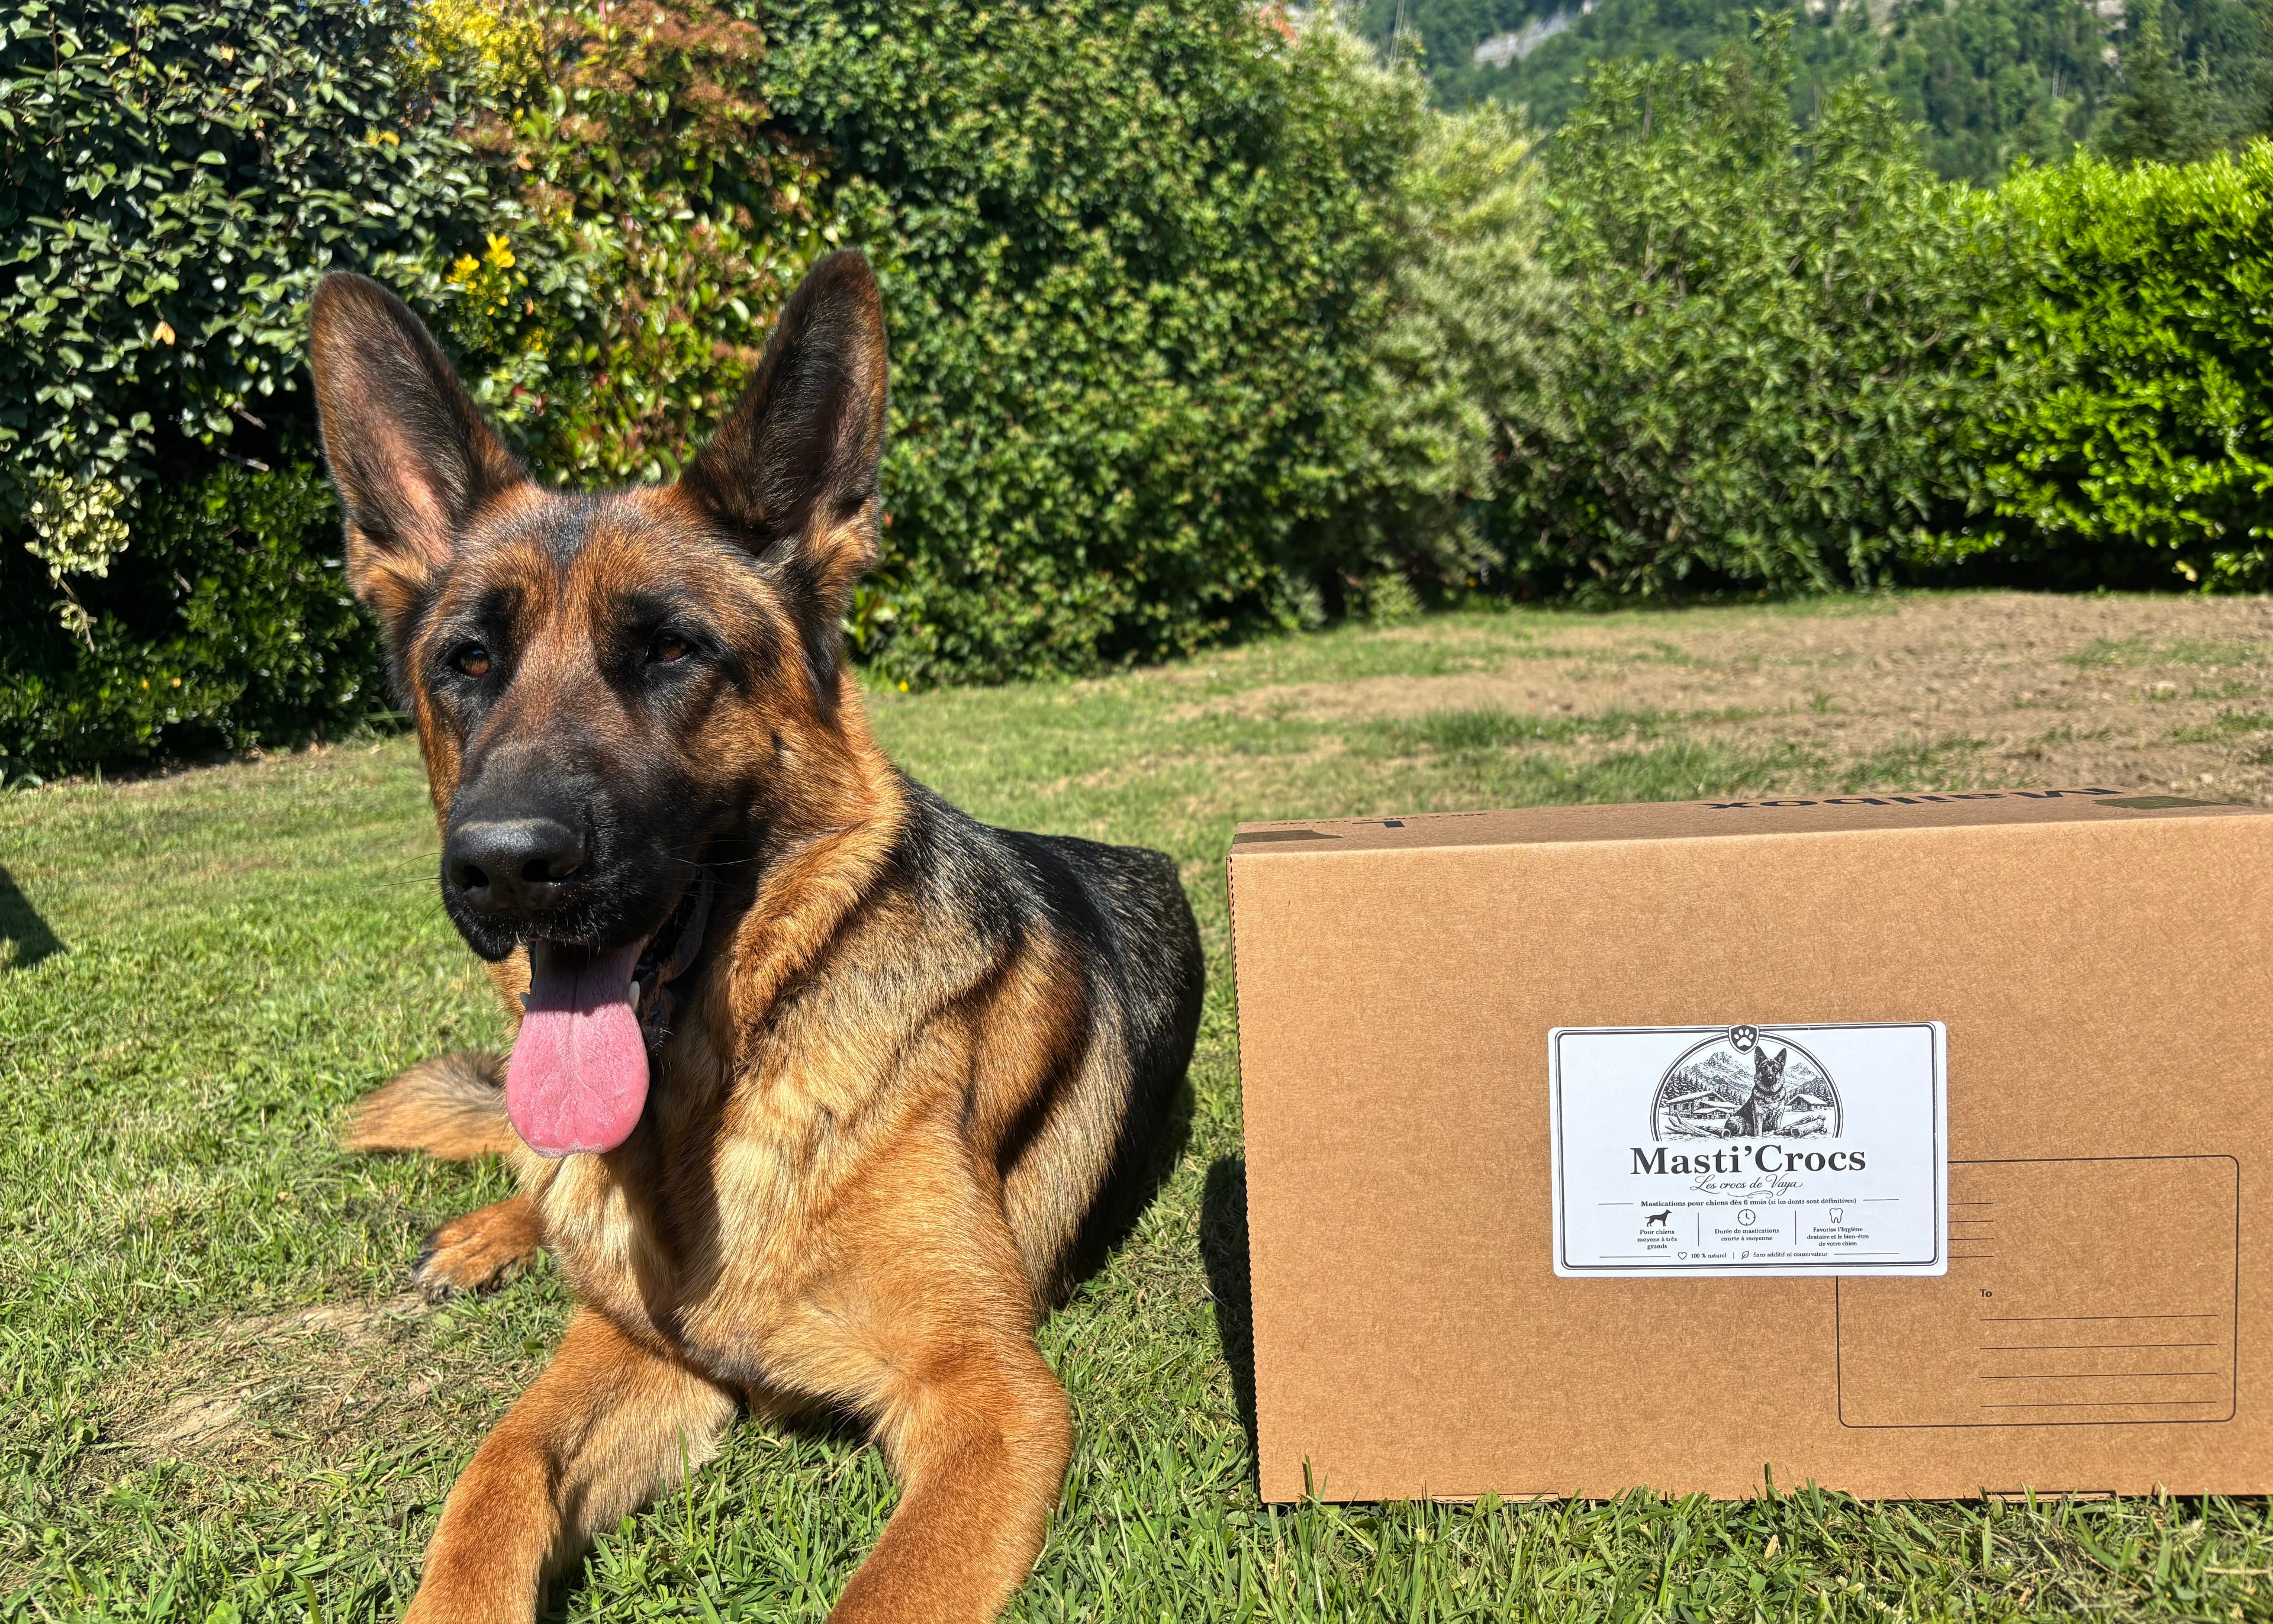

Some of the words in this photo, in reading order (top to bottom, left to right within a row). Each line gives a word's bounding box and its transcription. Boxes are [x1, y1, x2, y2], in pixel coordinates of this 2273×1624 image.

[1701, 788, 2124, 809] Mailbox
[1630, 1145, 1866, 1175] Masti'Crocs
[1690, 1174, 1721, 1194] Les
[1750, 1177, 1762, 1188] de
[1765, 1174, 1802, 1197] Vaya
[1767, 1197, 1776, 1206] (si
[1979, 1288, 1992, 1297] To
